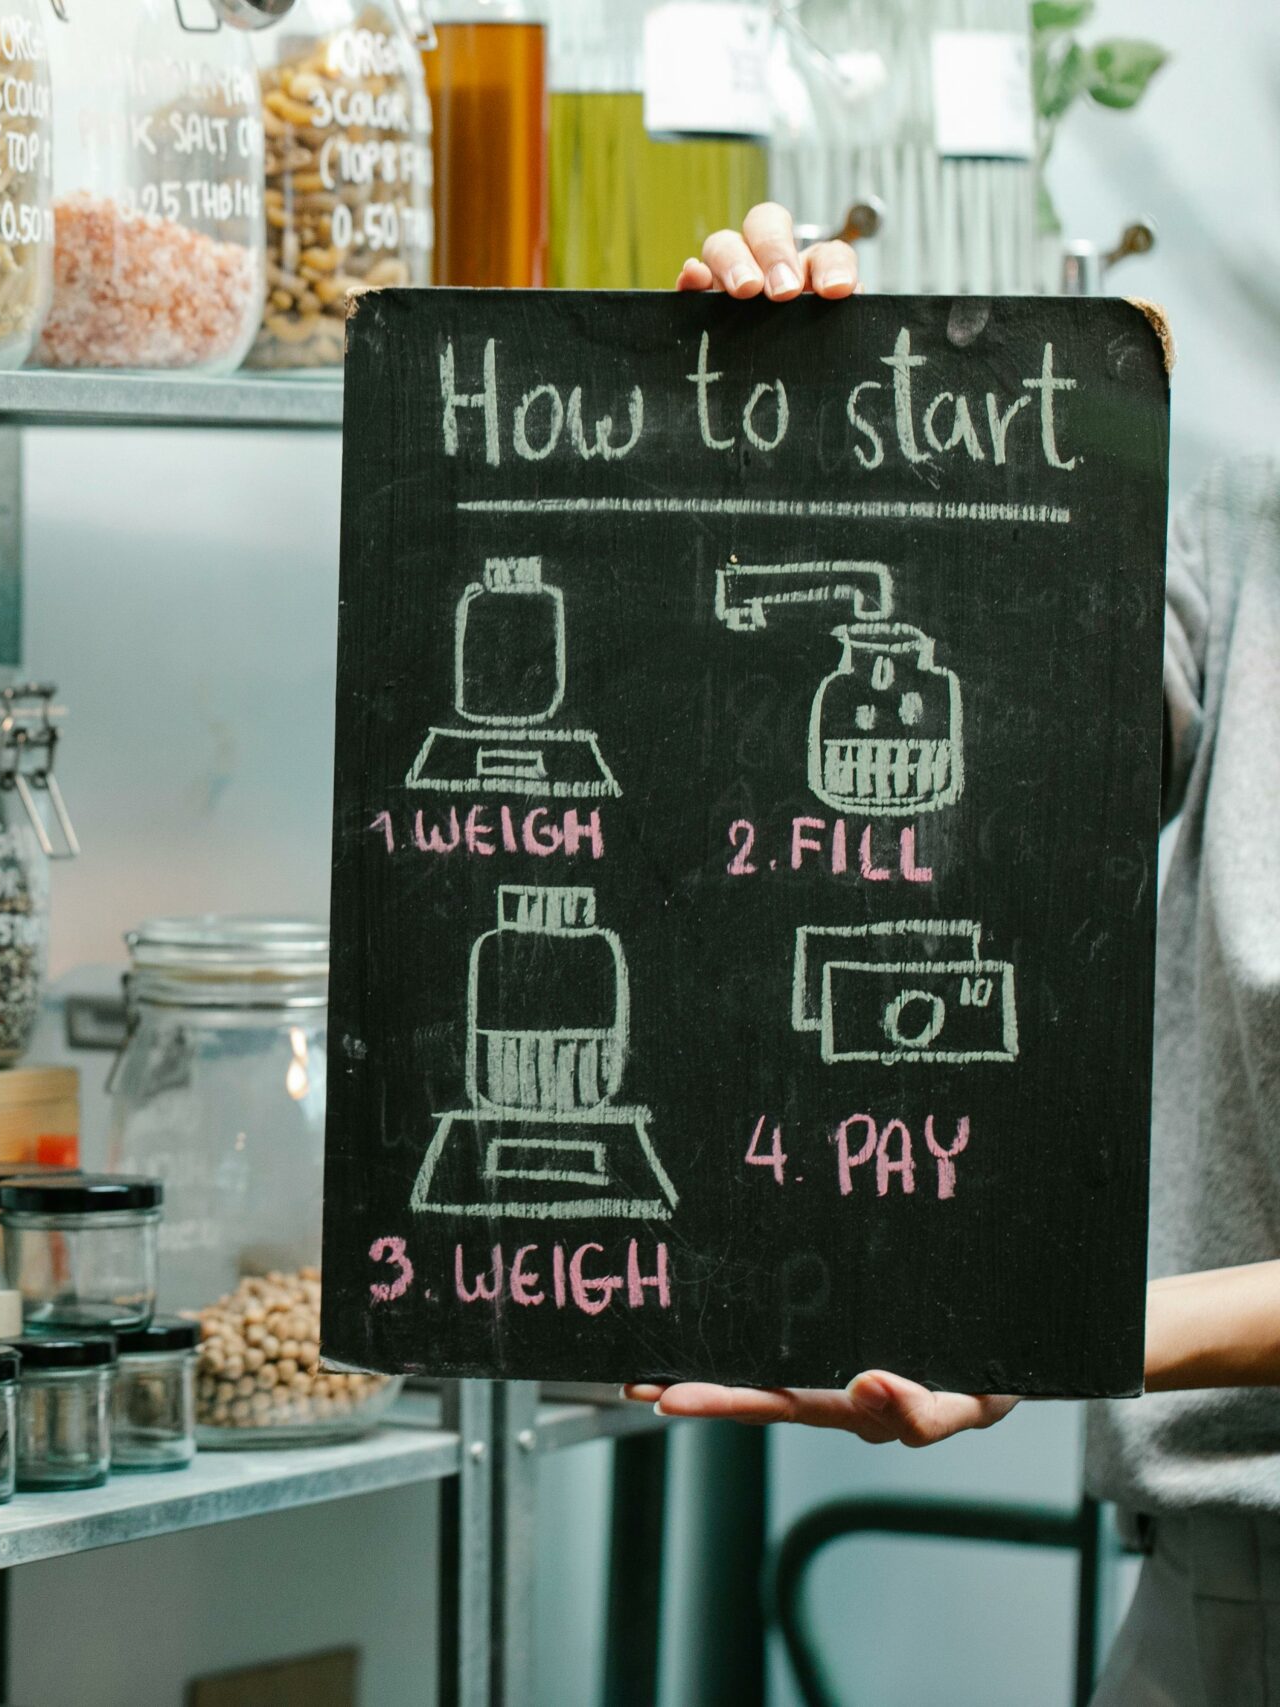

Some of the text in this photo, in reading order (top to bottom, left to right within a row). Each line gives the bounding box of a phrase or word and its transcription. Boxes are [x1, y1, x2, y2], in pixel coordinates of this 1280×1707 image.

[169, 111, 229, 160] SALT
[439, 326, 1085, 471] How to start
[414, 804, 605, 860] WEIGH
[726, 816, 934, 883] 2. FILL
[836, 1112, 970, 1200] PAY
[454, 1238, 671, 1316] WEIGH
